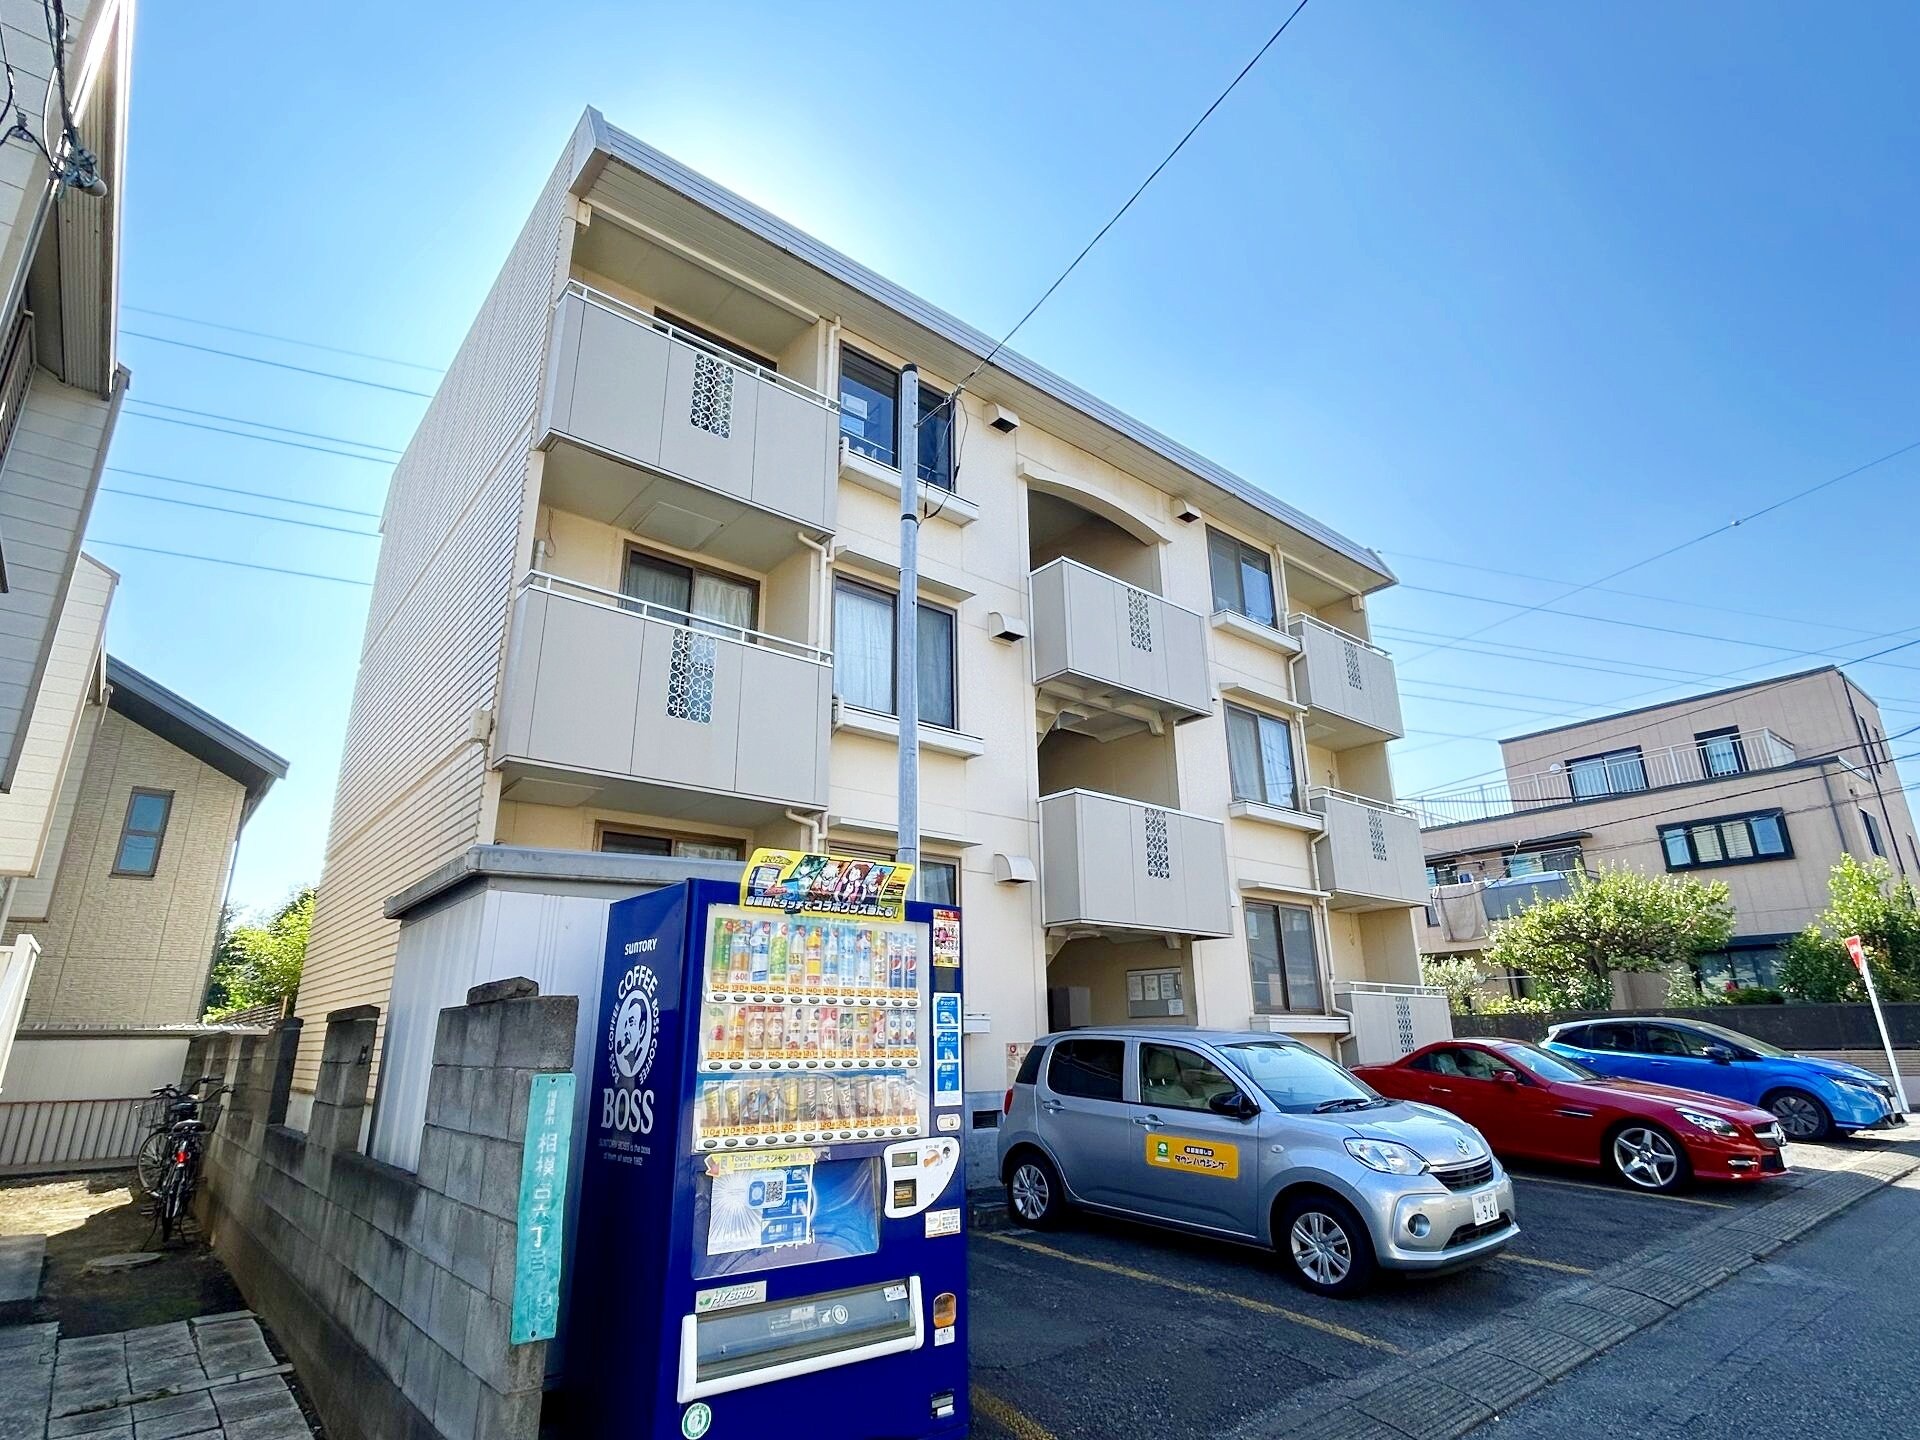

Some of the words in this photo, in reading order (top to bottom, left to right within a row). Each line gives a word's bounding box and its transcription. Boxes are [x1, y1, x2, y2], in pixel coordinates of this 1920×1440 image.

[624, 938, 658, 956] SUNTORY
[618, 965, 659, 1000] COFFEE
[600, 1088, 655, 1134] BOSS
[1174, 1154, 1229, 1171] タウンハウジング
[708, 1287, 757, 1309] HYBRID
